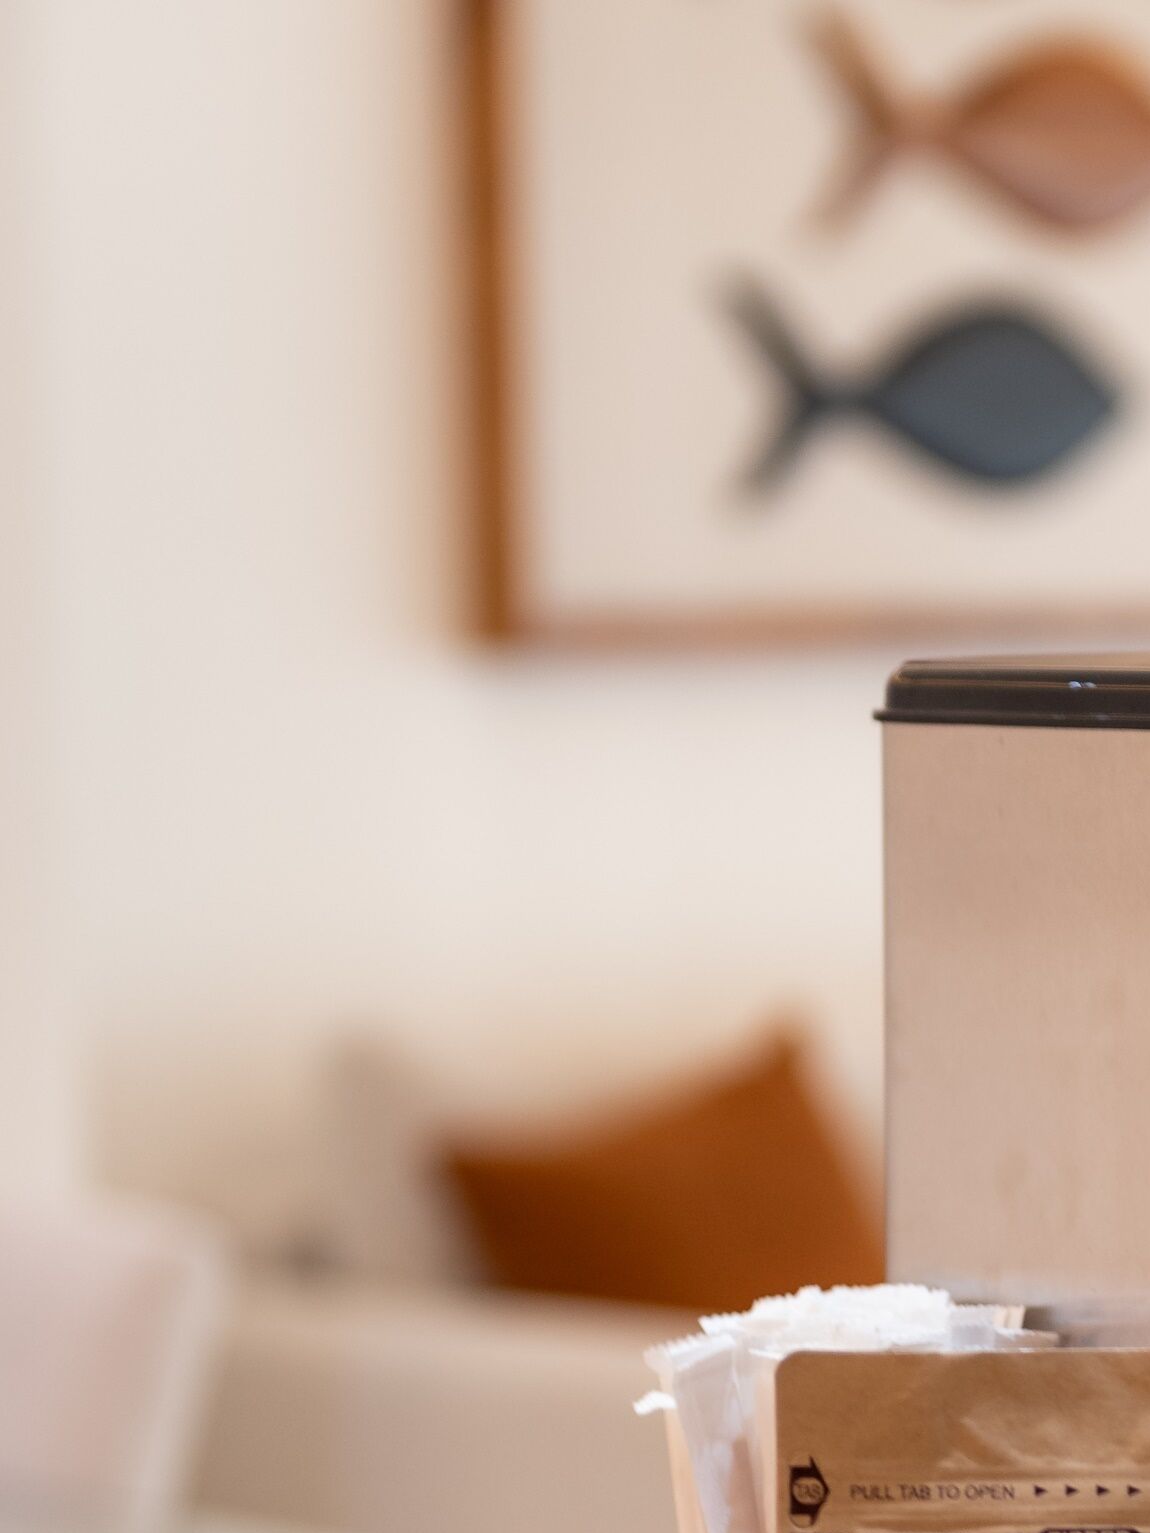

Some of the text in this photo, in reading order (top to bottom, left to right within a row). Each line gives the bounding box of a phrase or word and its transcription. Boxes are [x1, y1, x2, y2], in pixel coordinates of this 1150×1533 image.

[851, 1484, 1015, 1500] PULL TAB TO OPEN
